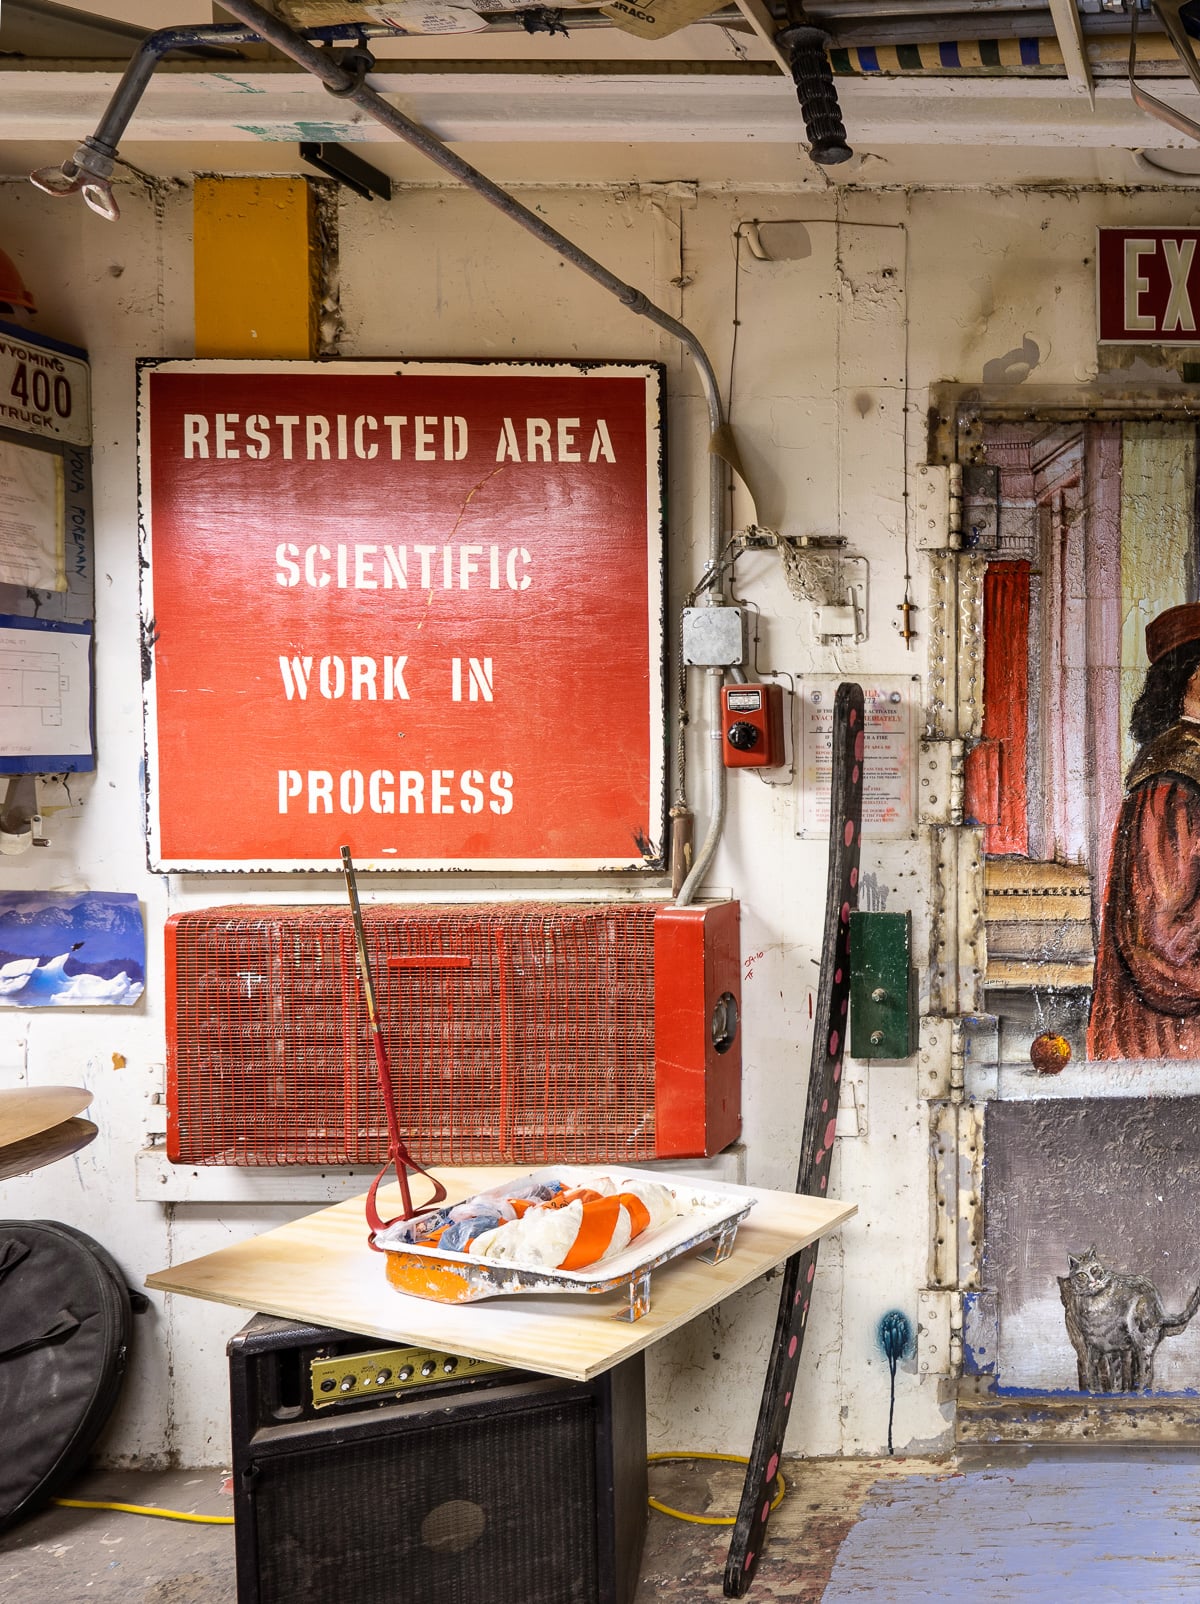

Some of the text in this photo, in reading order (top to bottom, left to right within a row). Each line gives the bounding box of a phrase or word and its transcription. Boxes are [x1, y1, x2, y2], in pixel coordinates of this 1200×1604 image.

[10, 361, 72, 418] 400
[183, 413, 617, 463] RESTRICTED AREA
[71, 505, 87, 579] FOREMAN
[275, 542, 532, 591] SCIENTIFIC
[278, 655, 494, 702] WORK IN
[278, 769, 514, 815] PROGRESS
